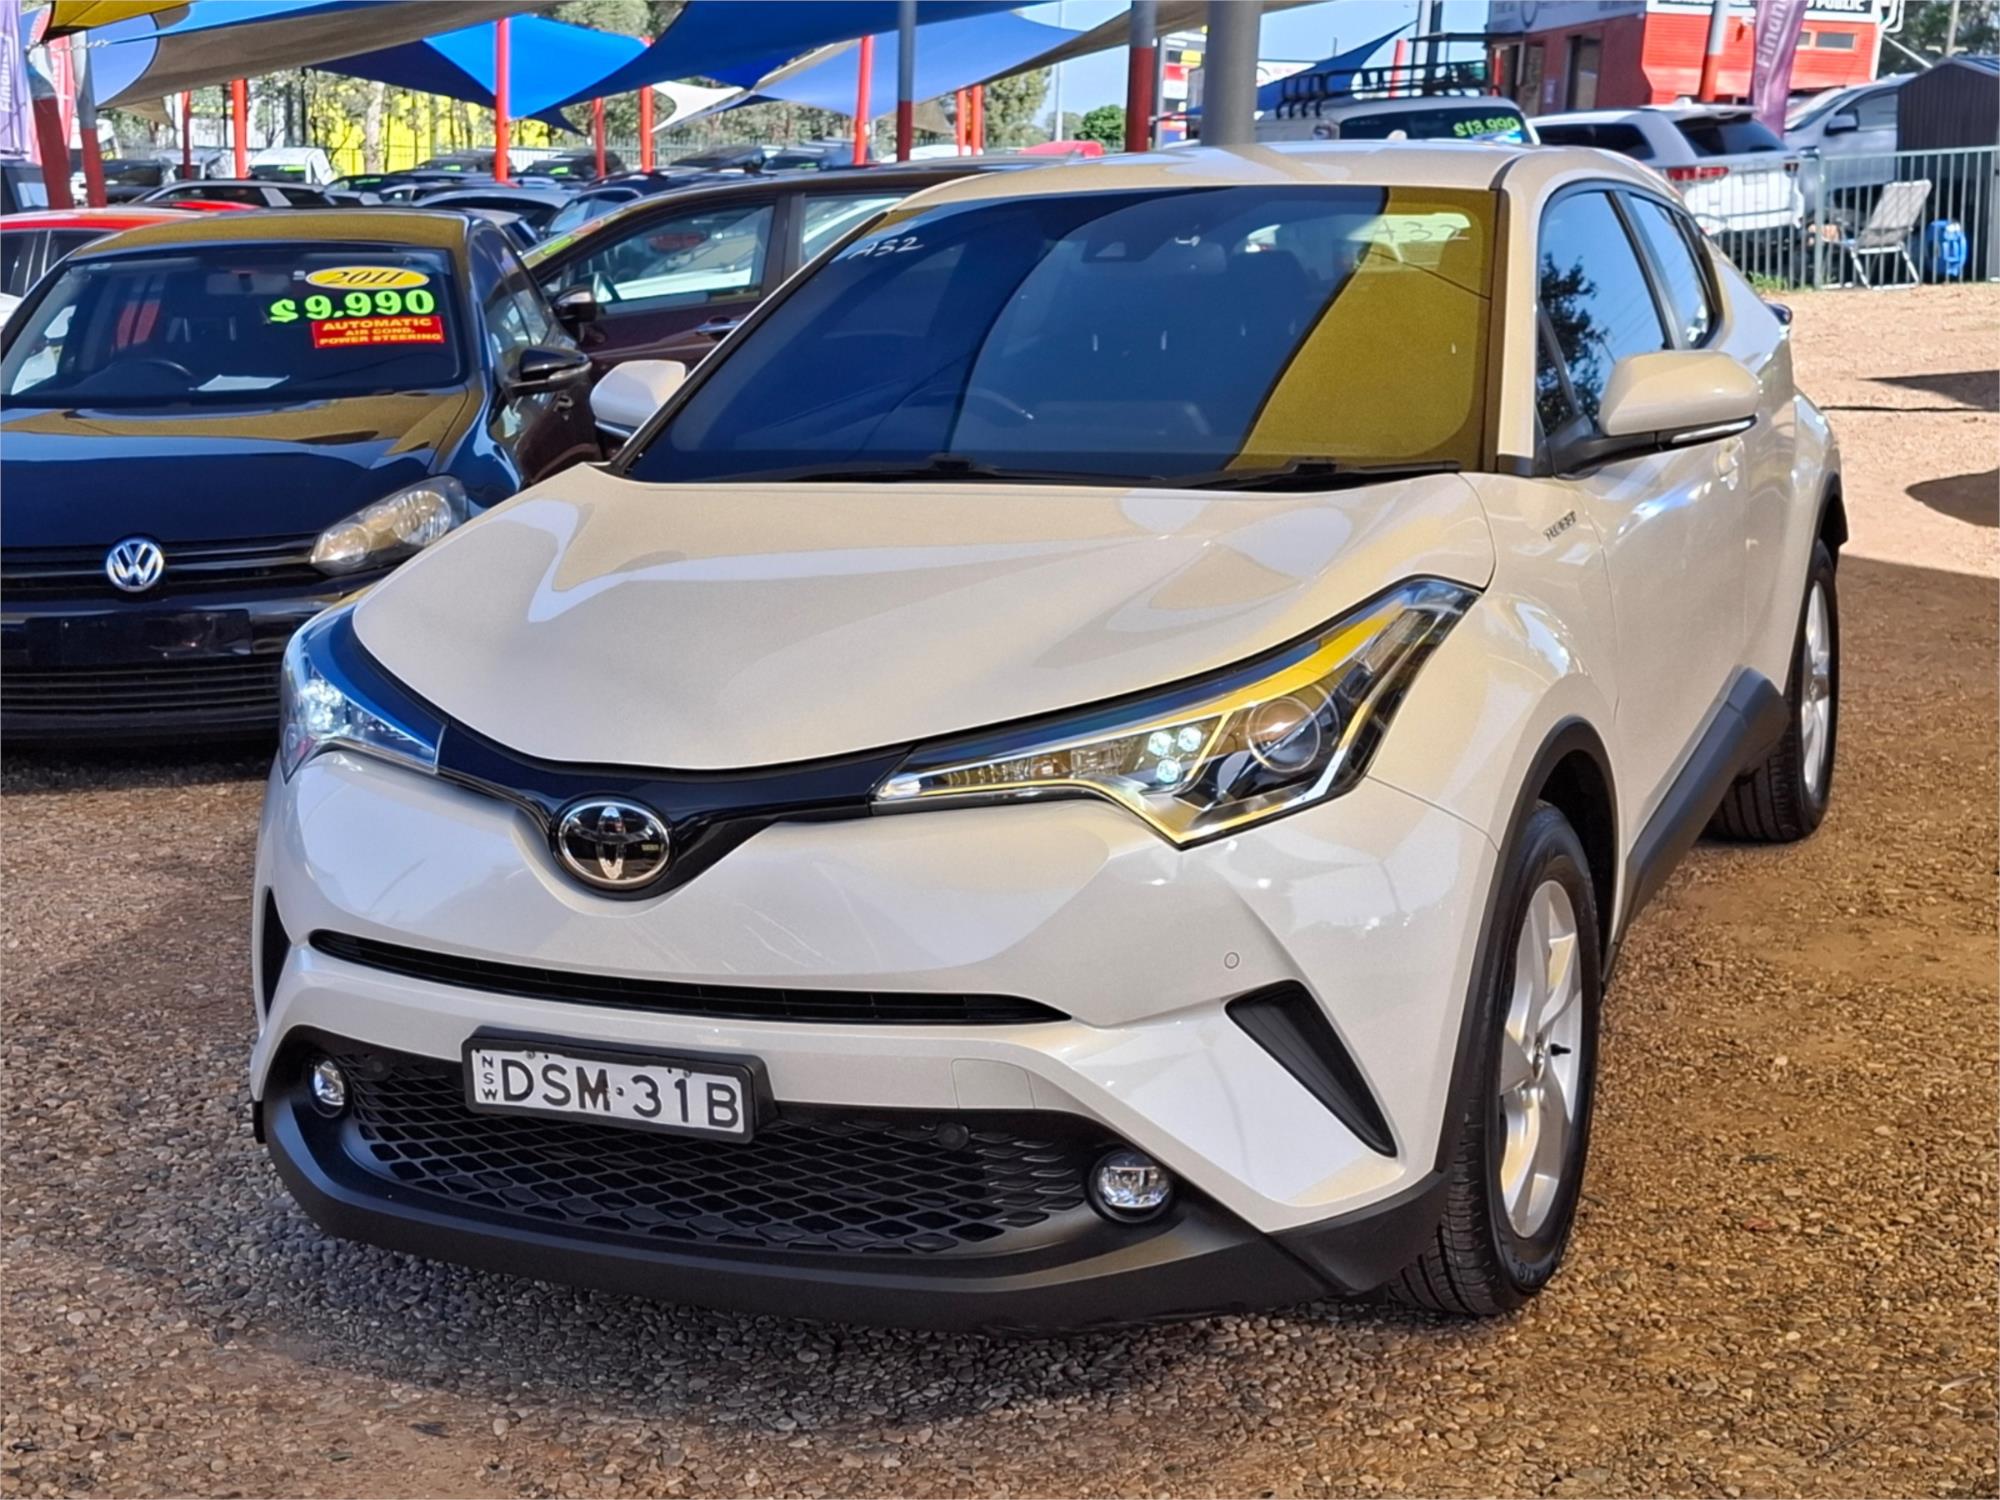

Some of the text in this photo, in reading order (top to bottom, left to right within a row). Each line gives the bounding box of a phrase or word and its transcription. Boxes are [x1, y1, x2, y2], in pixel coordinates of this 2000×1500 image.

[1756, 0, 1788, 68] Finan
[323, 270, 404, 285] 2011
[322, 318, 432, 331] AUTOMATIC
[319, 333, 442, 345] POWER STEERING
[345, 329, 369, 337] AIR
